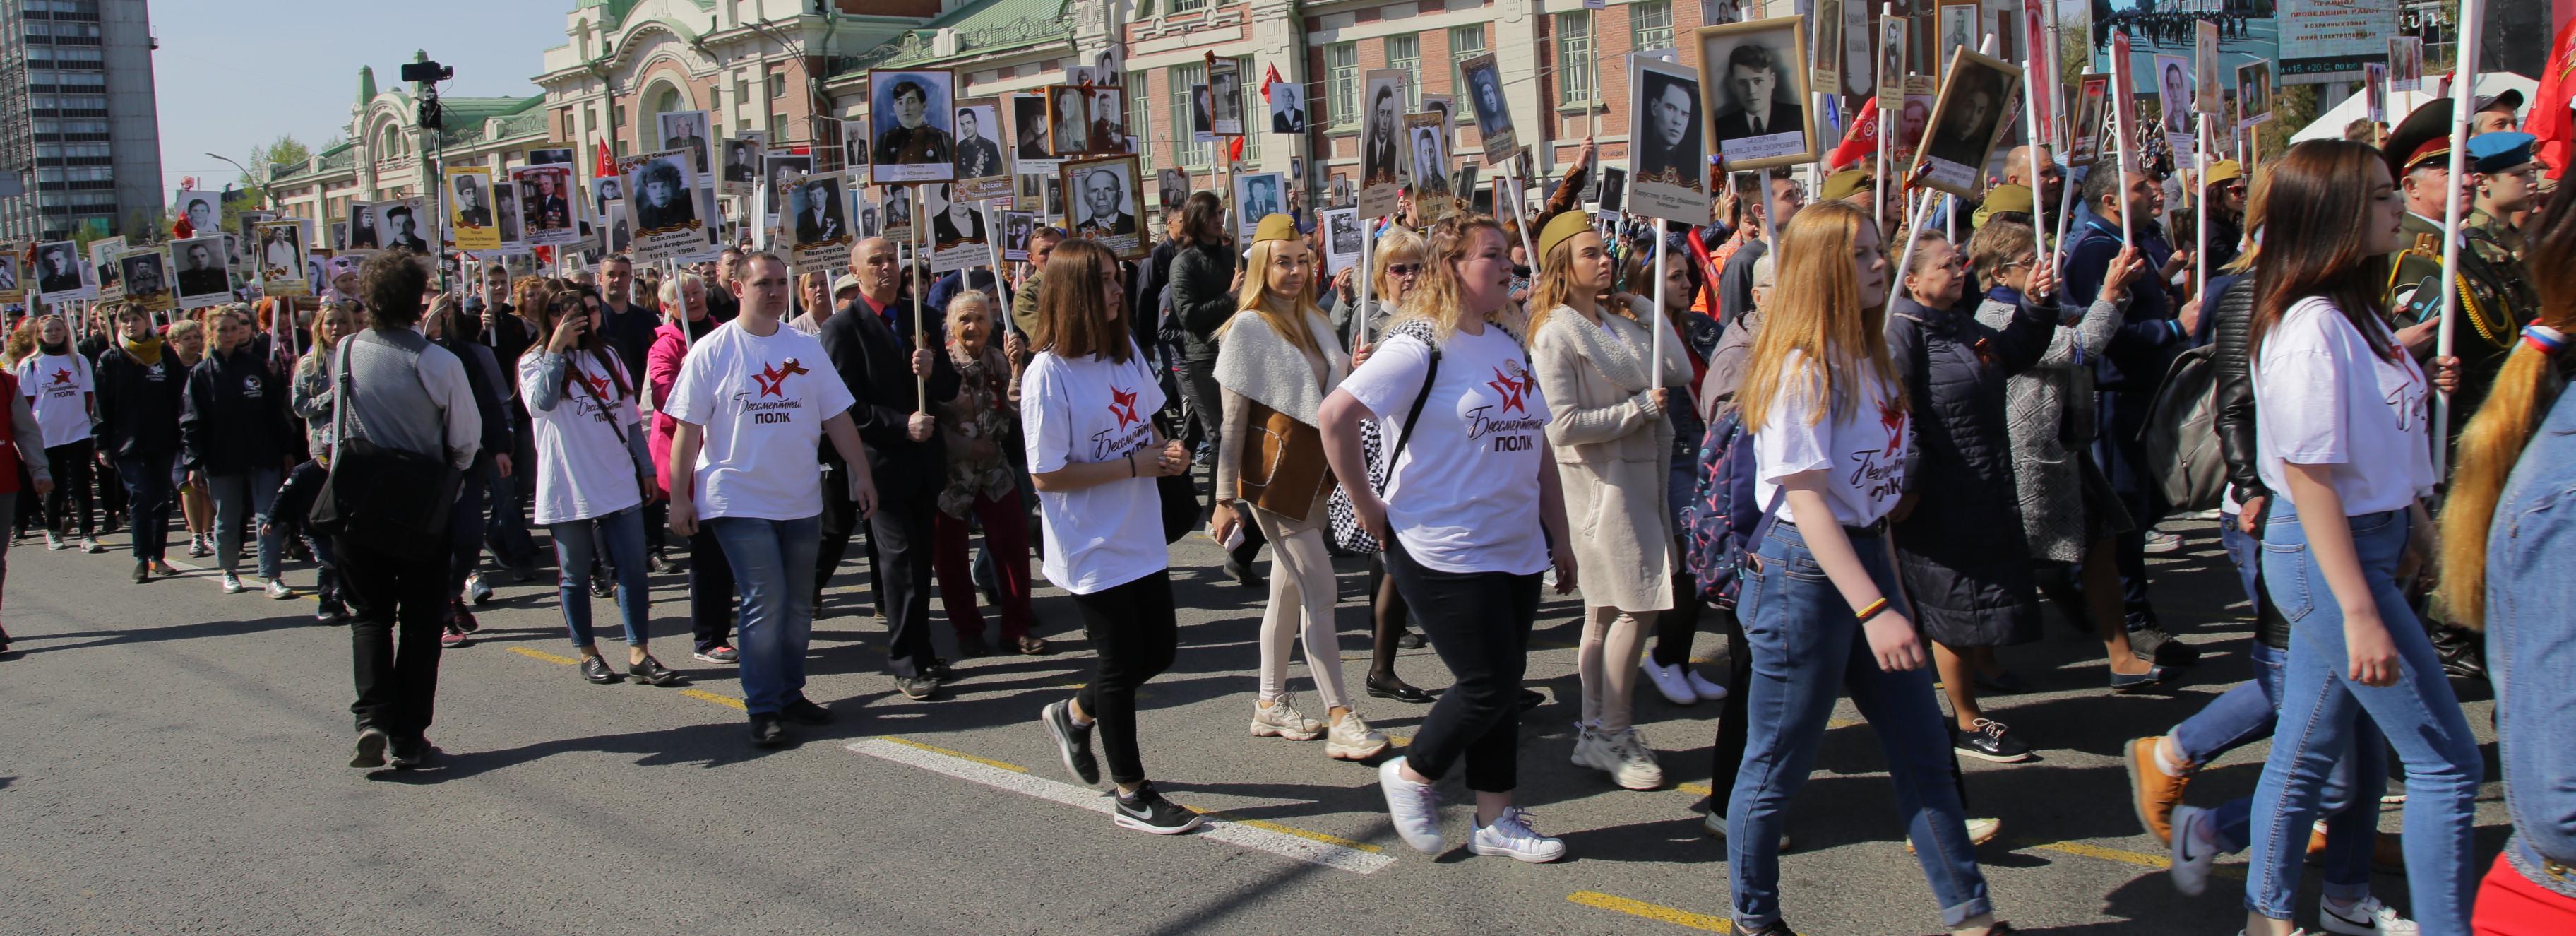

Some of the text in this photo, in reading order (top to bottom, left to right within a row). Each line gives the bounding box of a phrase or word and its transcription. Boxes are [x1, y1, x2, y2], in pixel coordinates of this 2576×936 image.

[652, 149, 686, 158] Сержант
[979, 181, 1003, 191] Красюк
[650, 232, 691, 243] Бакланов
[638, 237, 705, 252] Андрей Агафонович
[804, 245, 845, 256] Мельчуков
[649, 251, 669, 260] 1919
[676, 247, 696, 255] 1996
[796, 252, 852, 266] Алексей Семёнов
[54, 390, 76, 398] ПОЛК
[734, 392, 803, 416] Бессмертный
[755, 412, 791, 424] ПОЛК
[1494, 434, 1534, 452] ПОЛК
